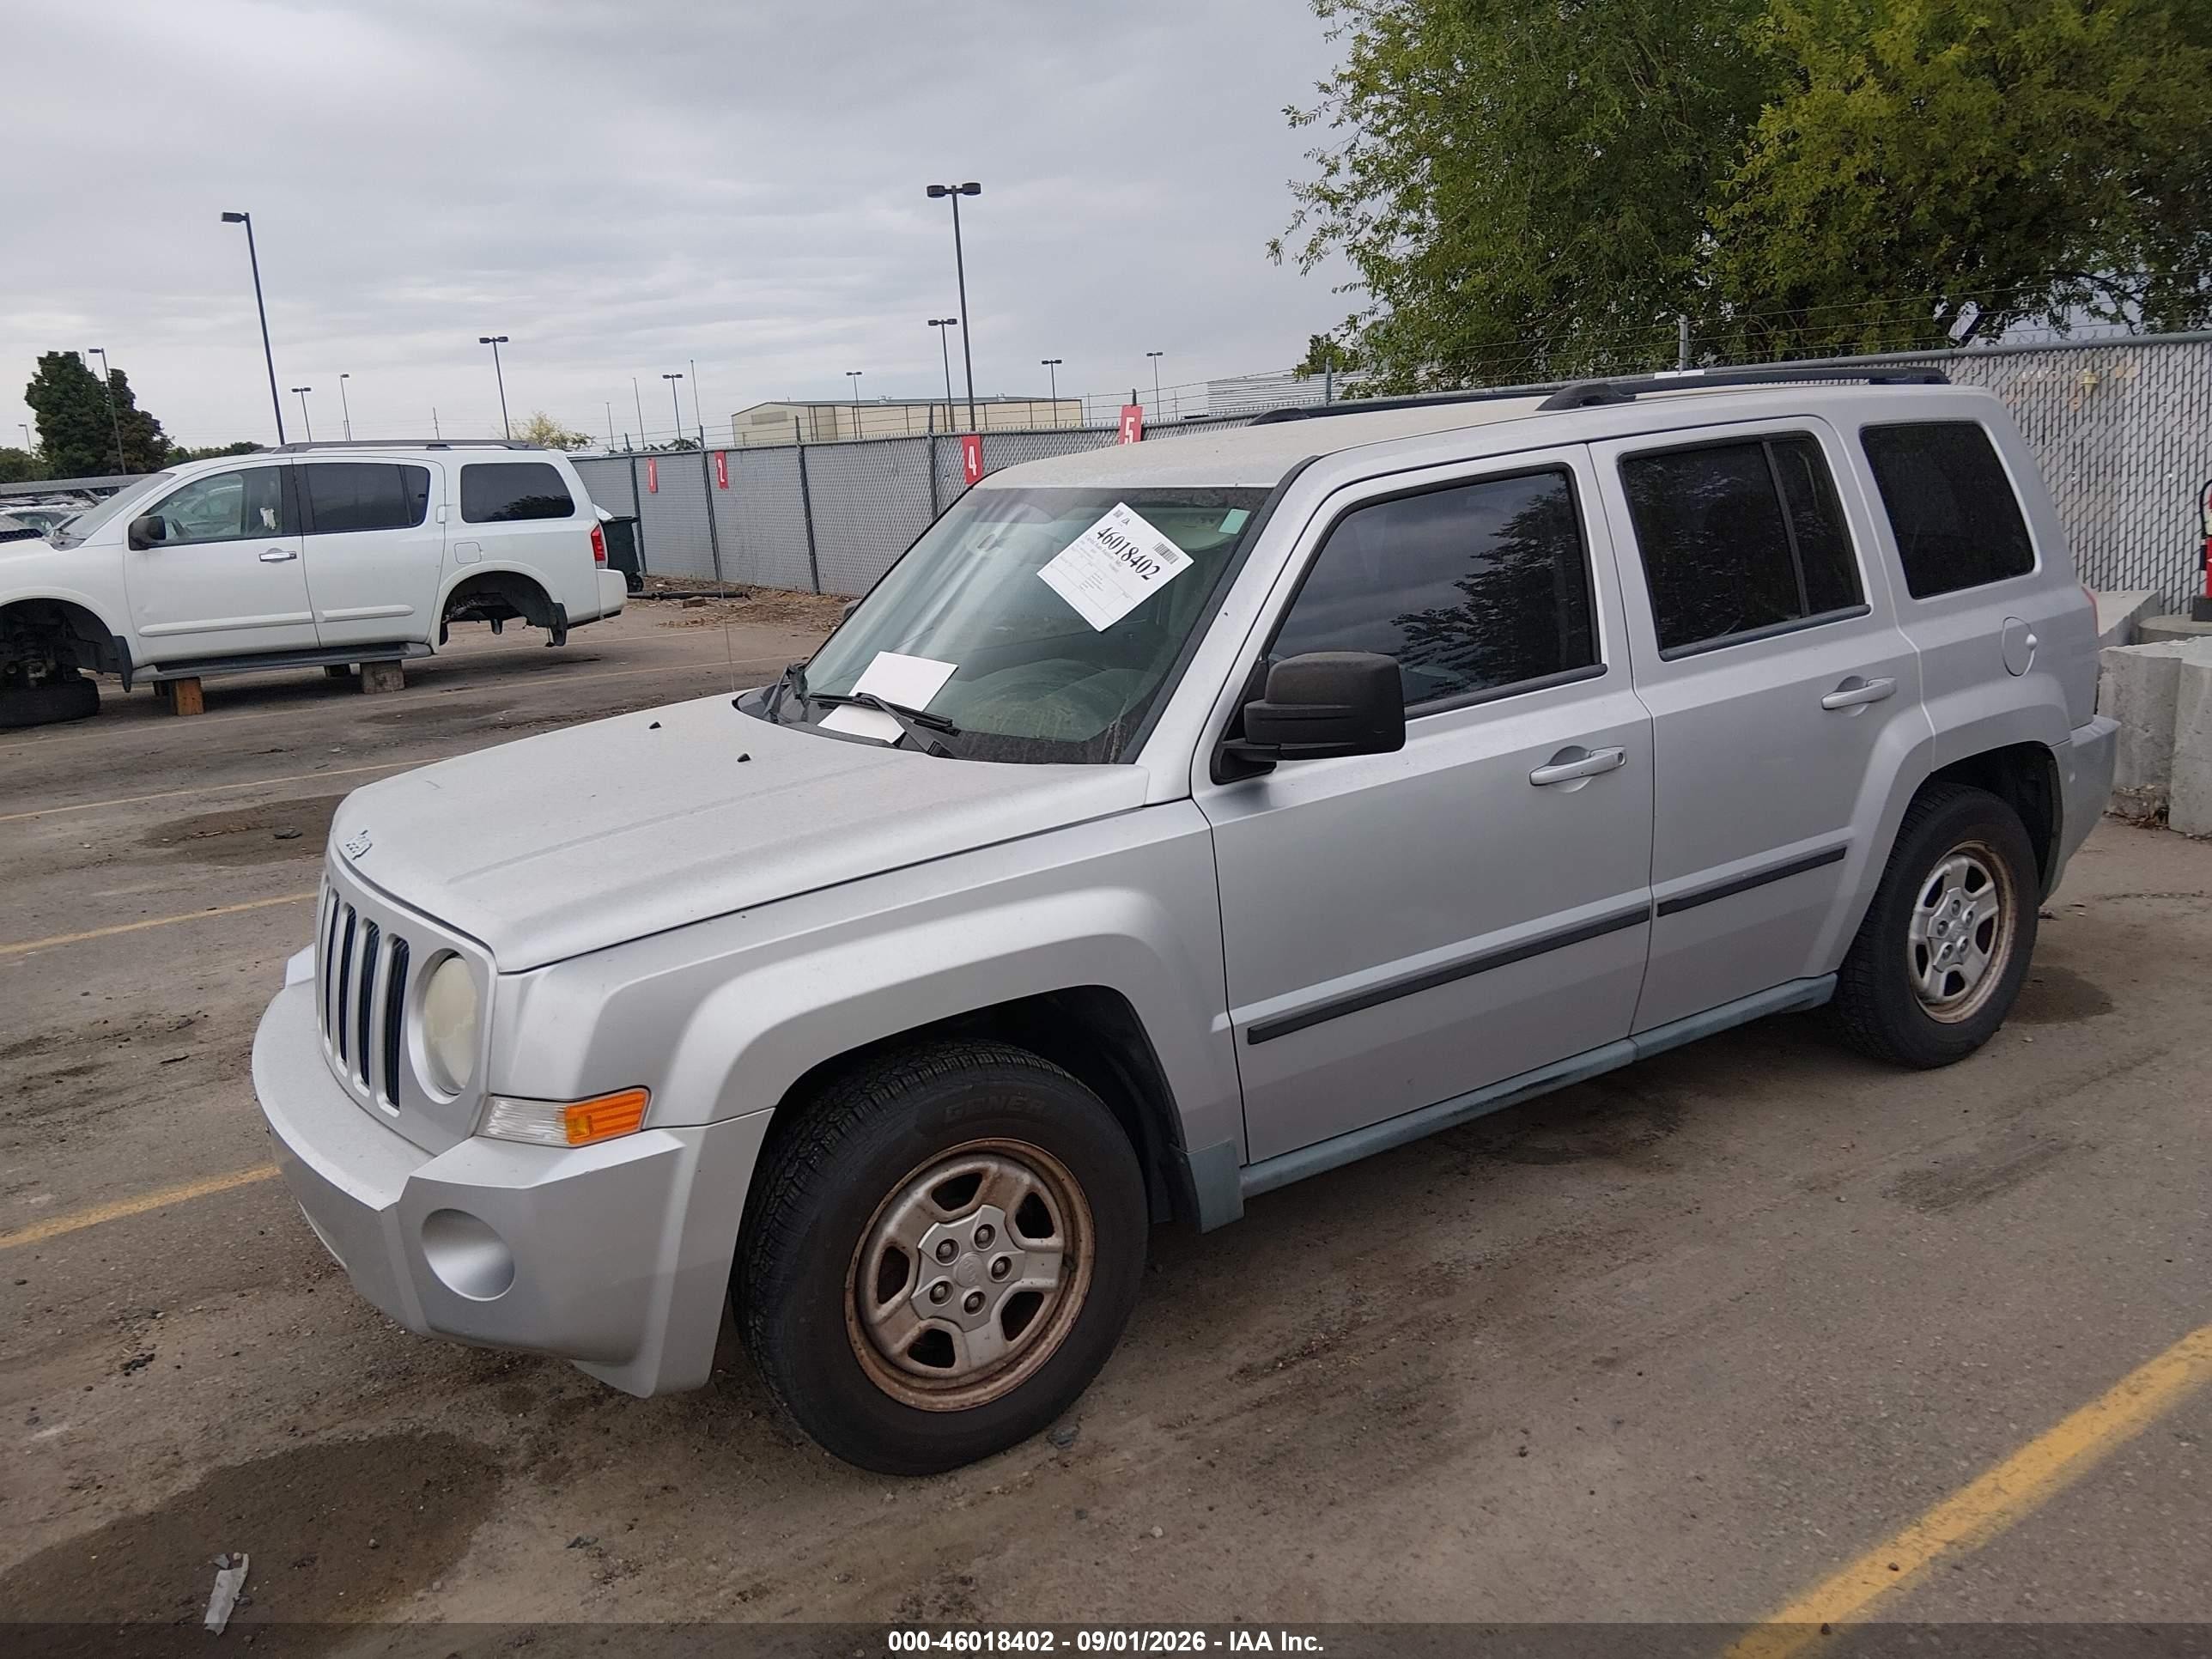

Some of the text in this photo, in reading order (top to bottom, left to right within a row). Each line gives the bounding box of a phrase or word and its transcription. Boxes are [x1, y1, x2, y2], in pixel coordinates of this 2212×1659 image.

[1125, 416, 1135, 445] 5
[717, 459, 726, 483] 2
[968, 446, 977, 476] 4
[1097, 526, 1161, 581] 46018402
